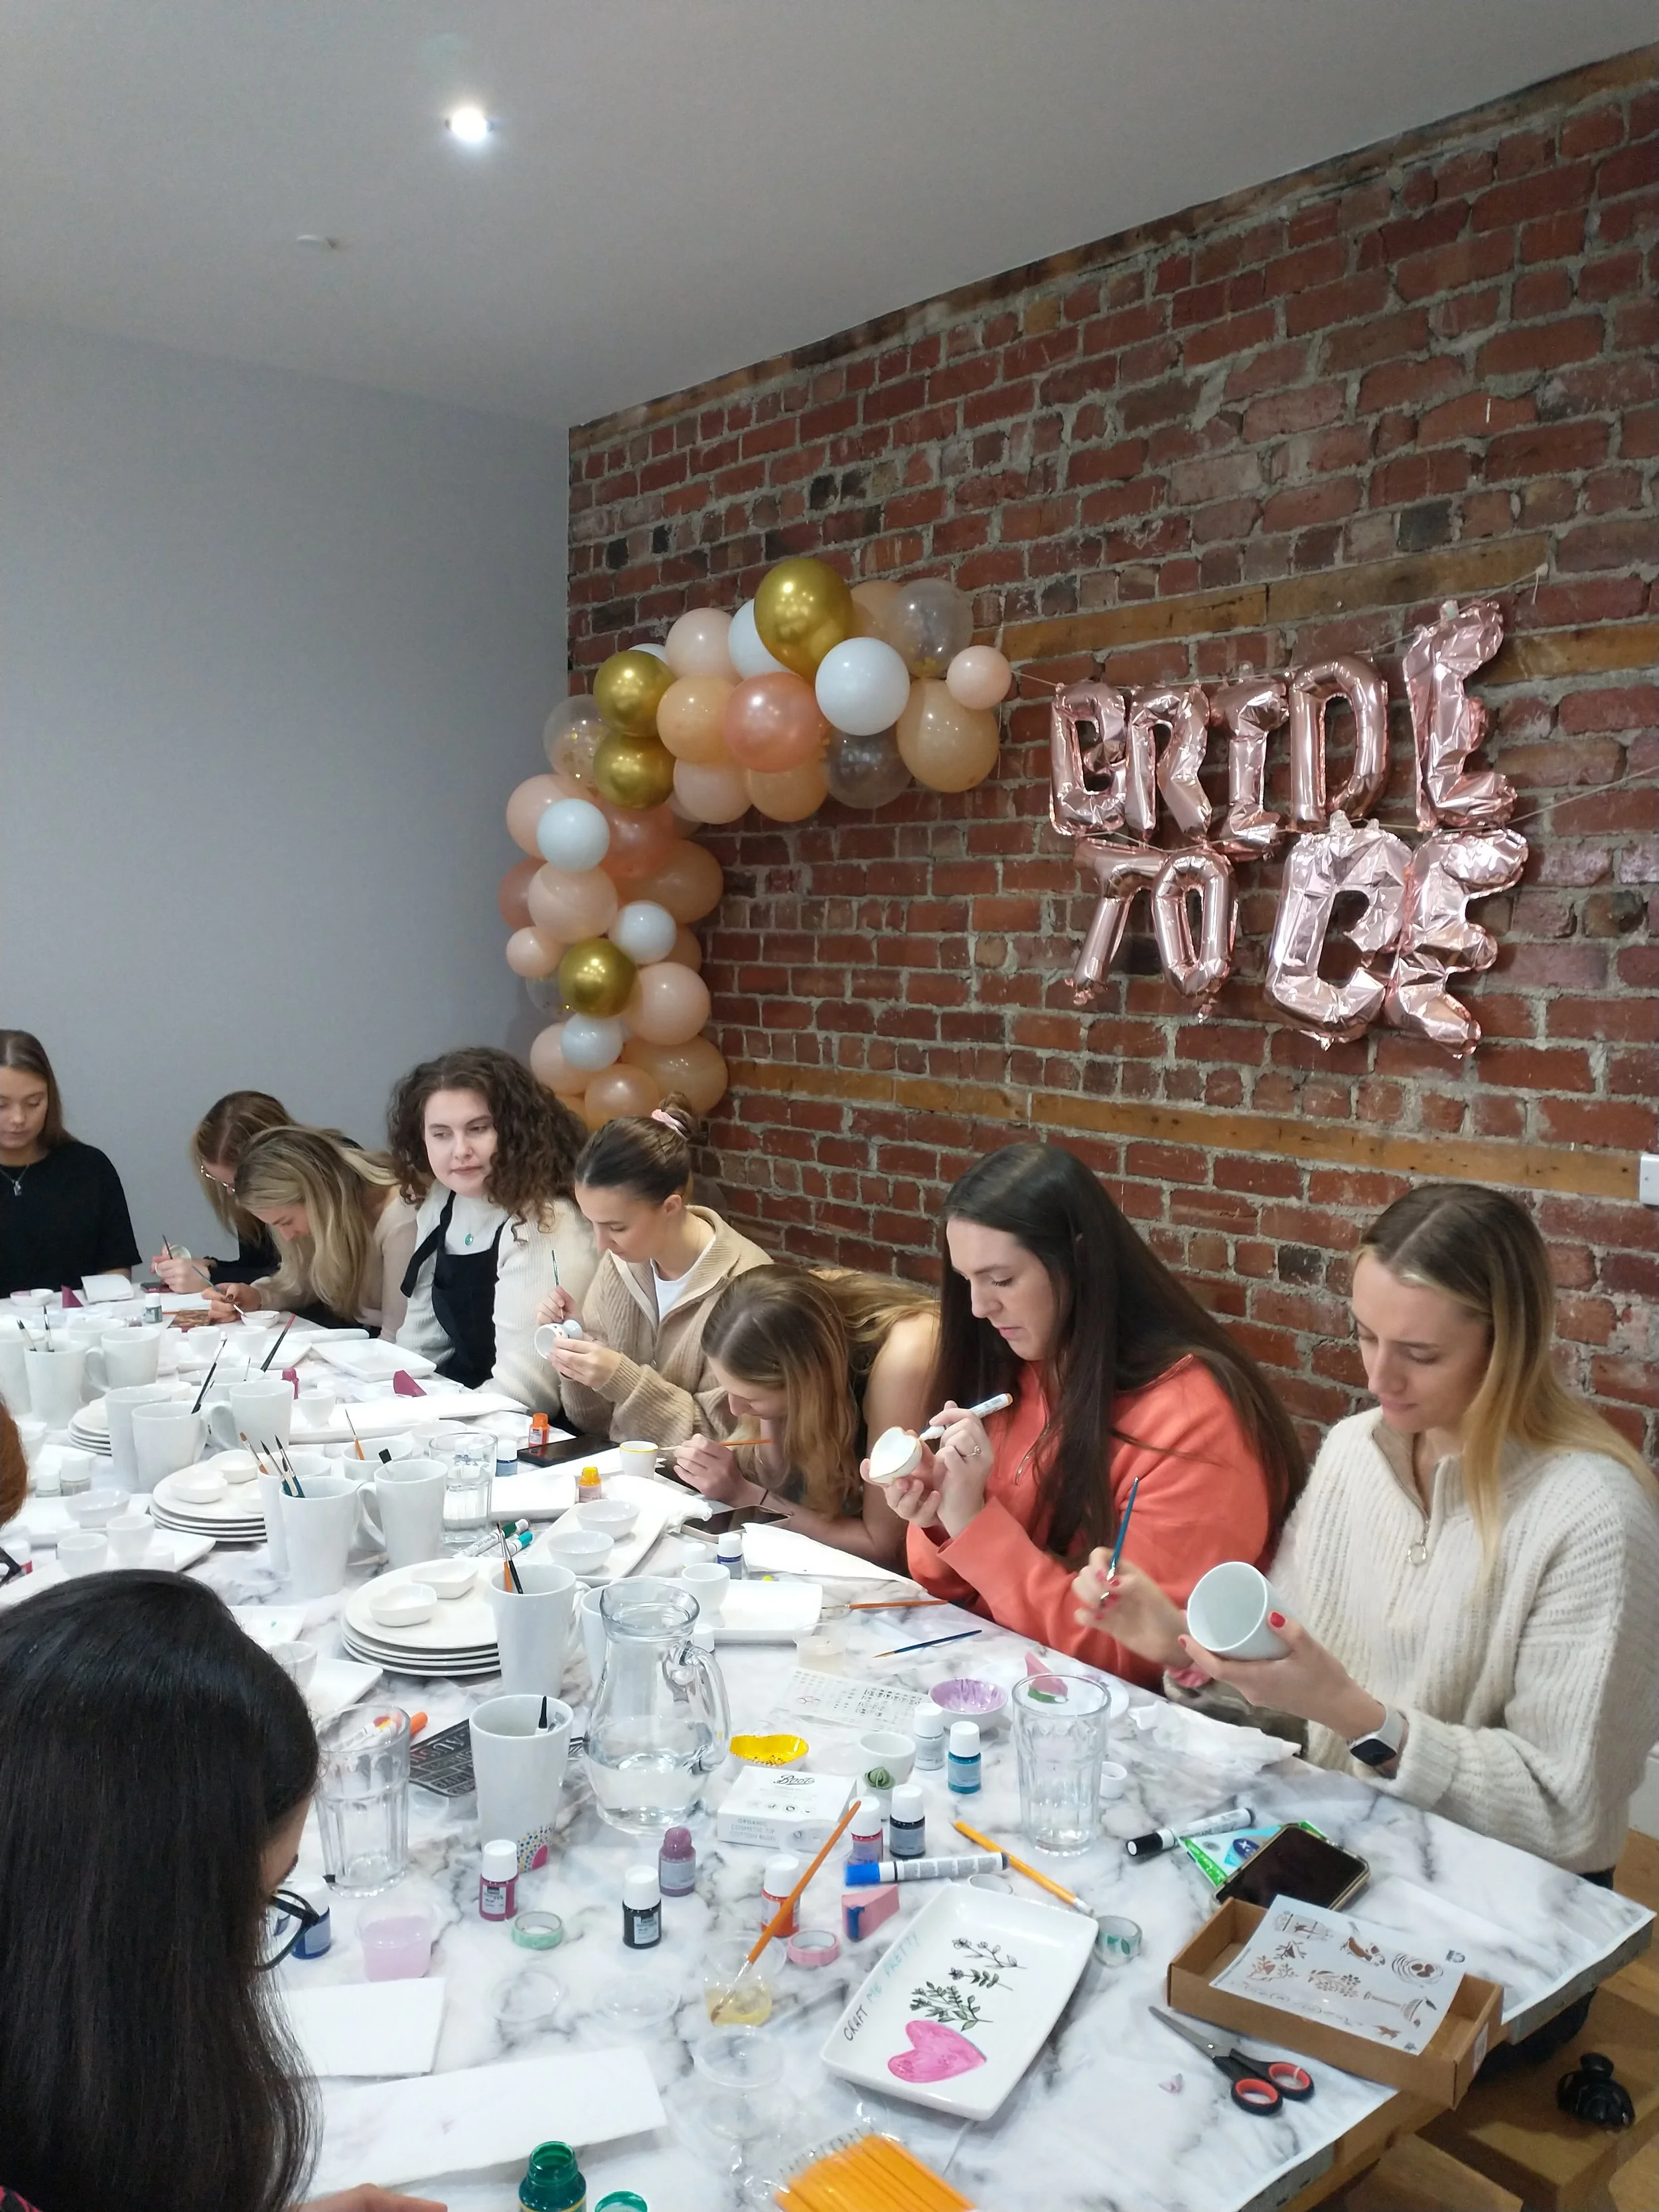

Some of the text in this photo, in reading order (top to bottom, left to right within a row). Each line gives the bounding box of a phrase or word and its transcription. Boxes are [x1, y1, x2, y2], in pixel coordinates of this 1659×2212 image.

[1049, 599, 1518, 861] BRIDE
[1064, 820, 1529, 1057] TO BE
[843, 2004, 869, 2041] CRAFT
